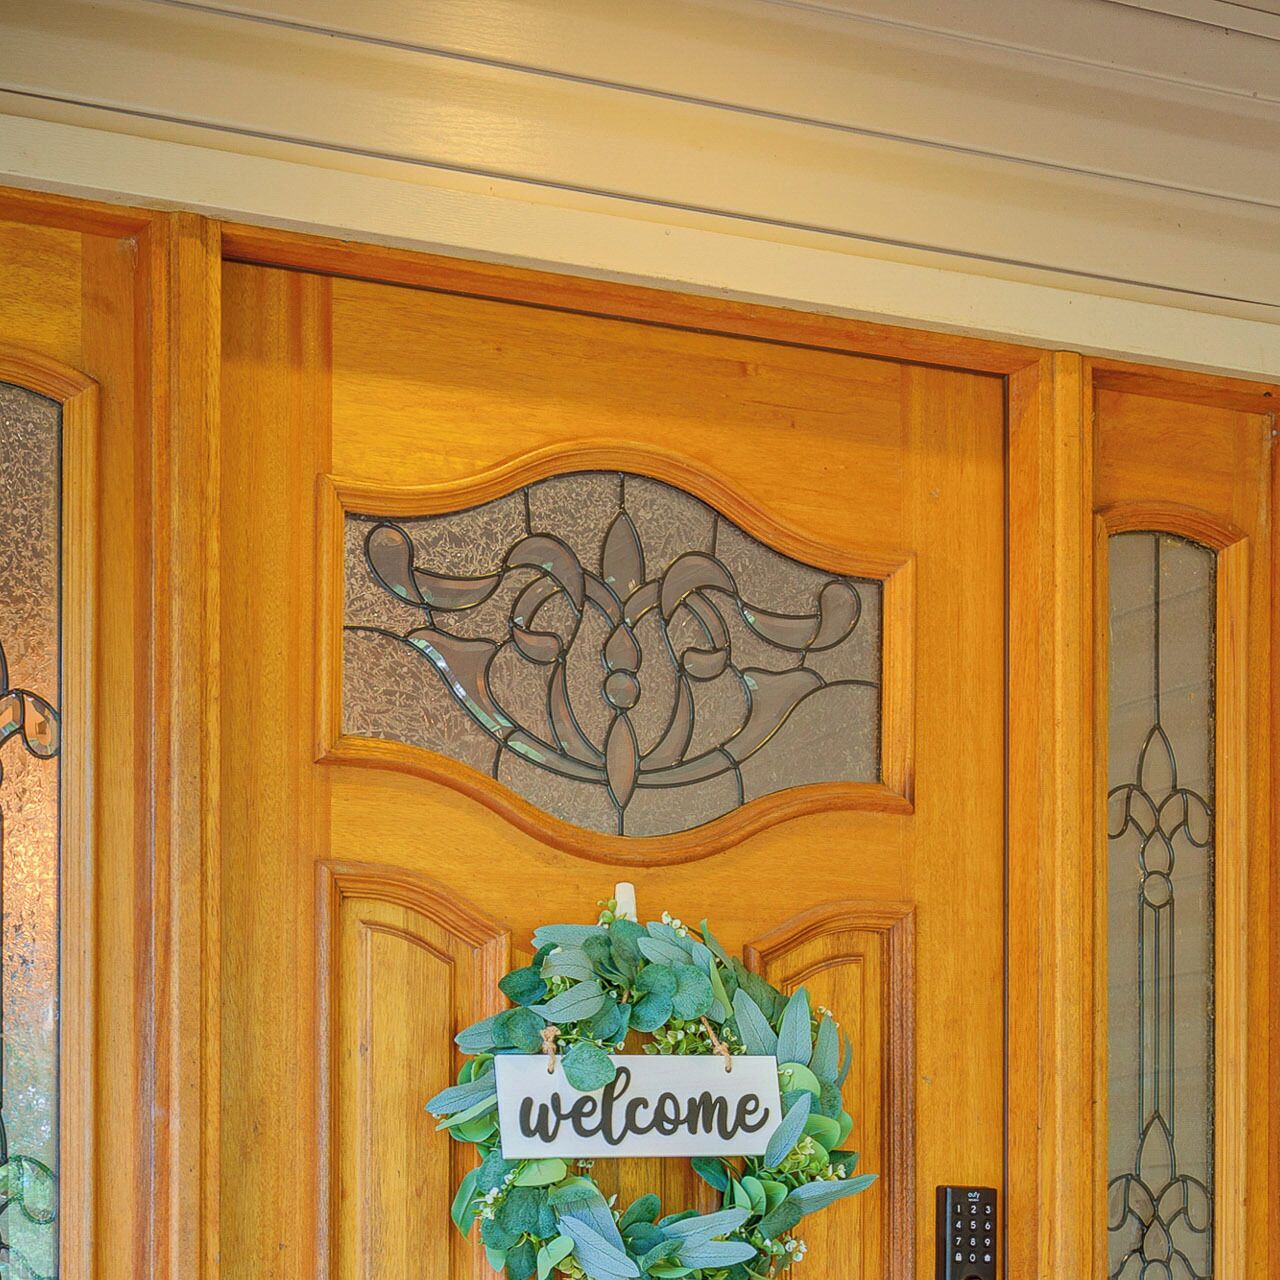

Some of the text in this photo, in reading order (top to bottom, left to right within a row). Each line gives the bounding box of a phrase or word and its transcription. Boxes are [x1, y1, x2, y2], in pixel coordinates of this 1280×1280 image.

[519, 1066, 770, 1146] welcome
[957, 1204, 991, 1214] 1 2 3
[955, 1220, 991, 1230] 4 5 6
[956, 1237, 991, 1247] 7 8 9
[969, 1253, 976, 1262] 0
